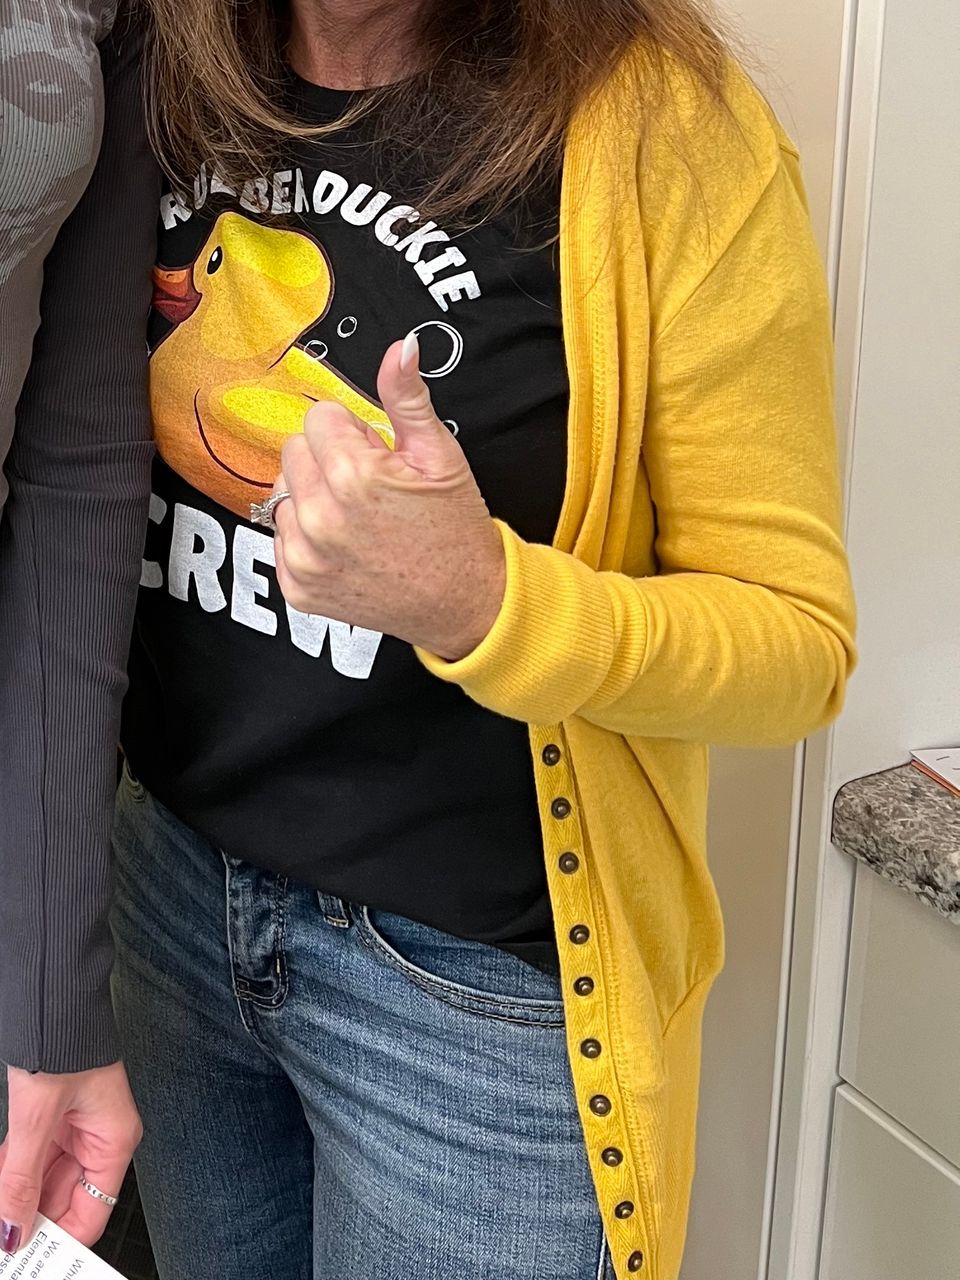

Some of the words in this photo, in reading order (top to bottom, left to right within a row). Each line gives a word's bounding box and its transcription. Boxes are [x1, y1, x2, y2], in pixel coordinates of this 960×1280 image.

[312, 169, 482, 313] DUCKIE
[9, 1231, 48, 1280] Elementa
[43, 1241, 60, 1259] We
